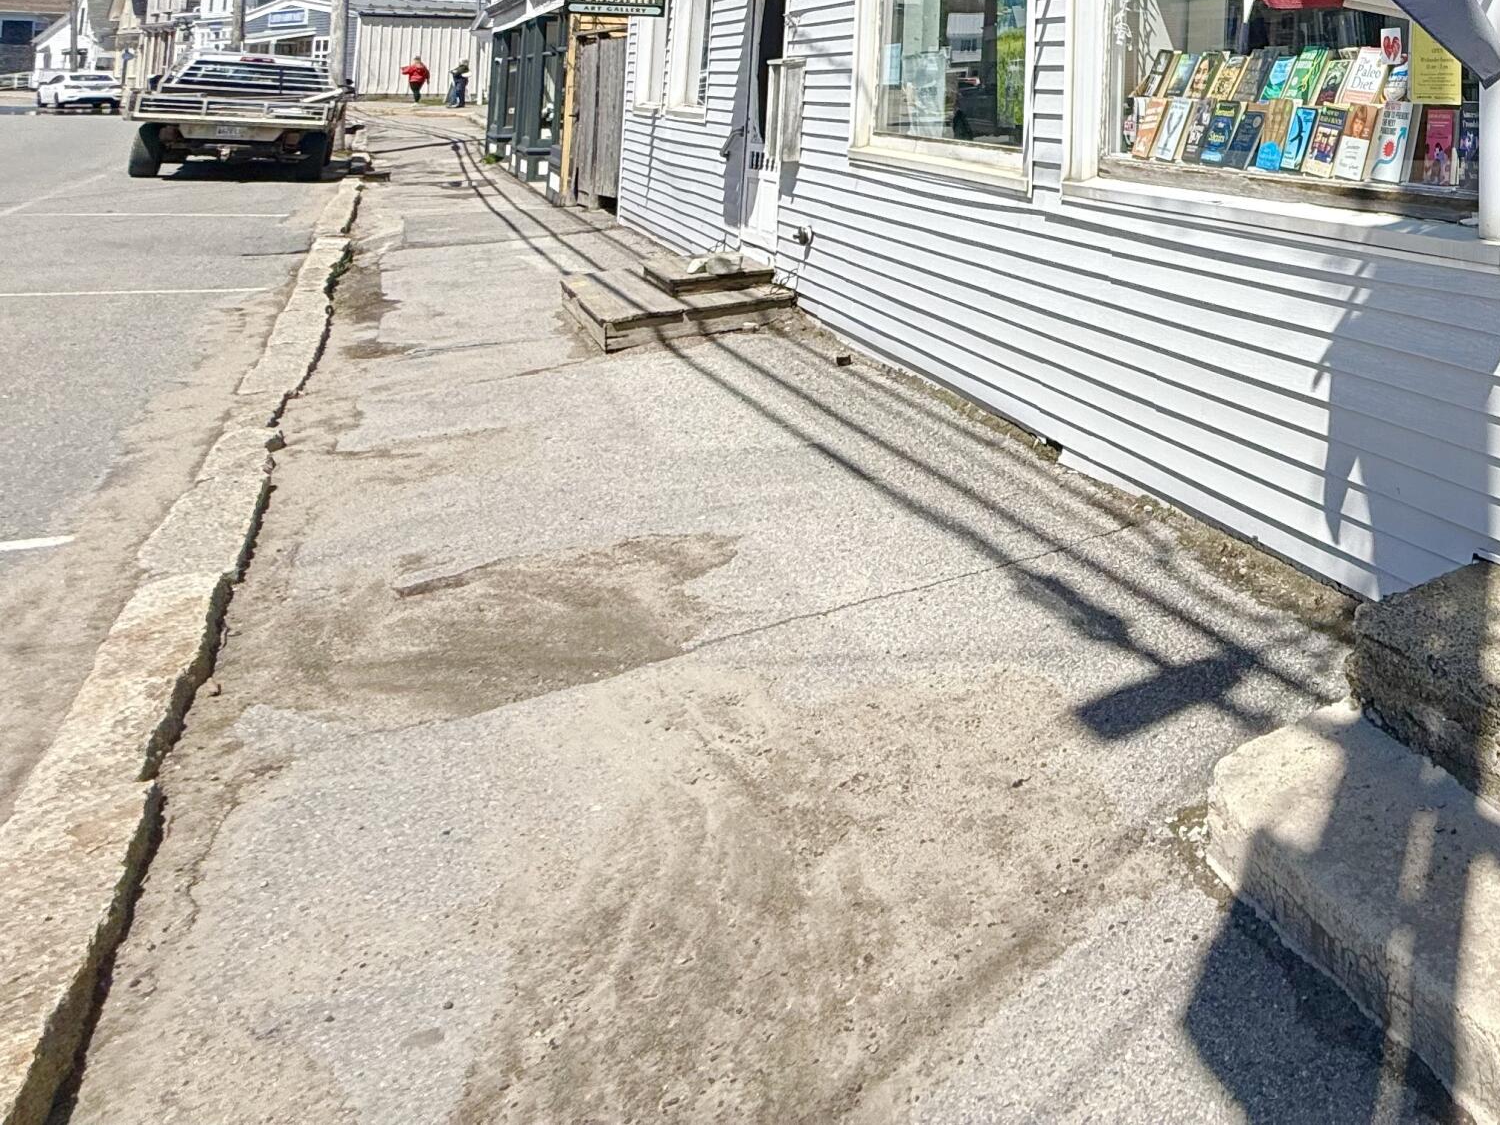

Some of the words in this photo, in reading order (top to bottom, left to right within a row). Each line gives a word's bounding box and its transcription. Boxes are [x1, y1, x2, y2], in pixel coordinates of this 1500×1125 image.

[606, 5, 647, 13] GALLERY
[1355, 64, 1381, 79] Paleo
[1350, 76, 1375, 91] Diet
